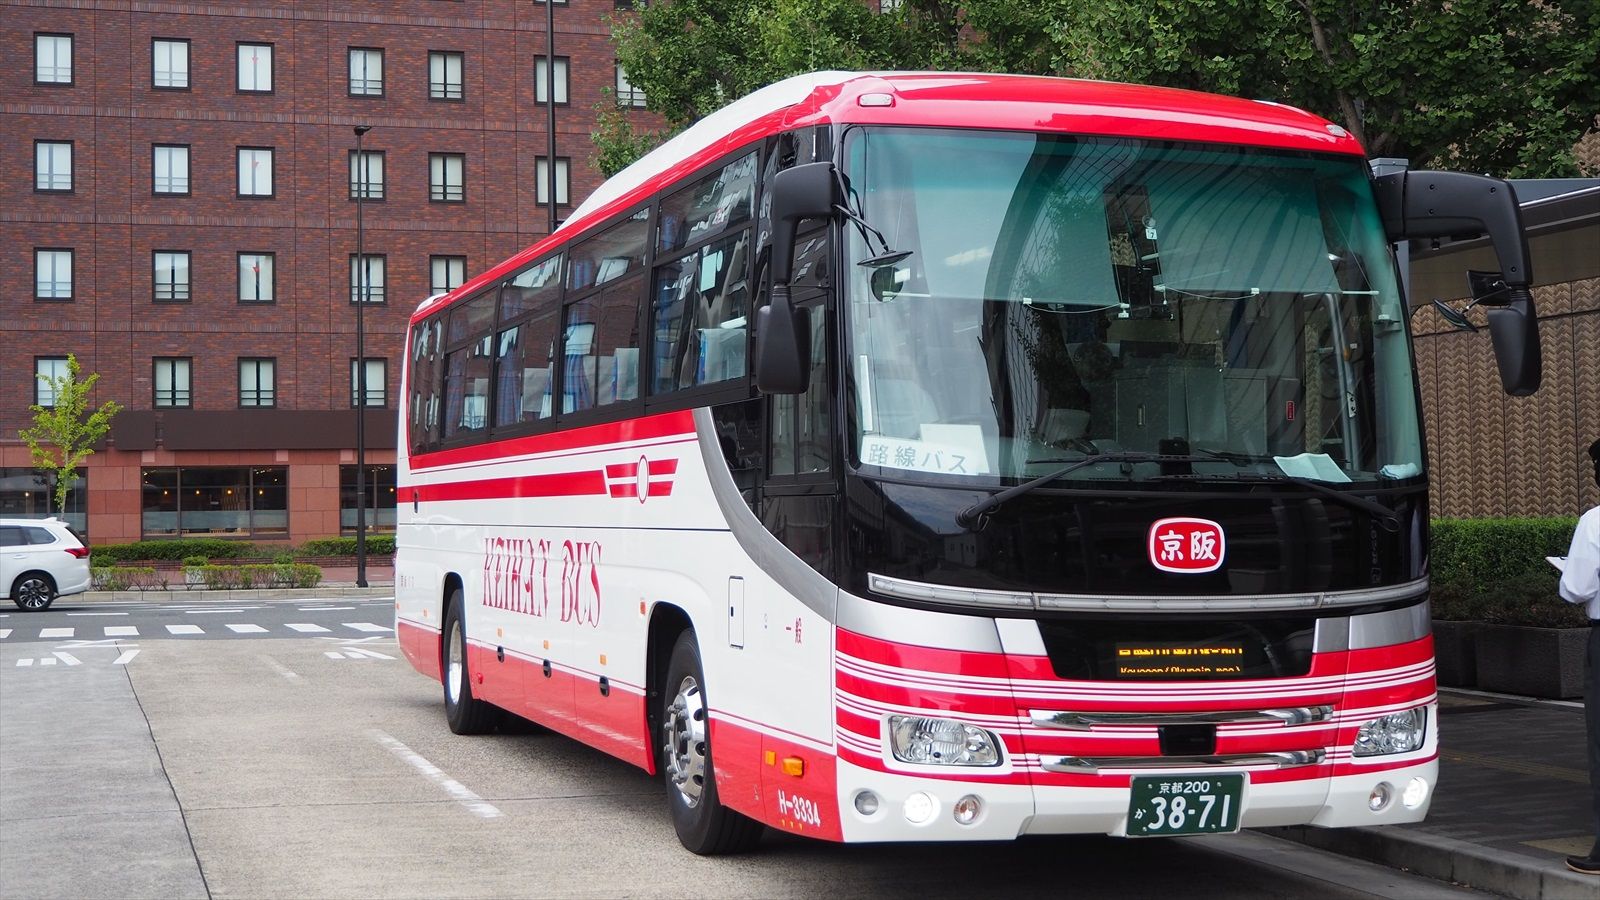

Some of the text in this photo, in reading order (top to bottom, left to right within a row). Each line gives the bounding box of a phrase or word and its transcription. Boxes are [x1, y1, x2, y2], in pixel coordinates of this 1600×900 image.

[868, 443, 967, 473] 路線バス
[1158, 529, 1217, 561] 京阪
[482, 537, 602, 629] KEIHAN BUS
[777, 788, 821, 828] H-3334
[1148, 794, 1231, 830] 38-71
